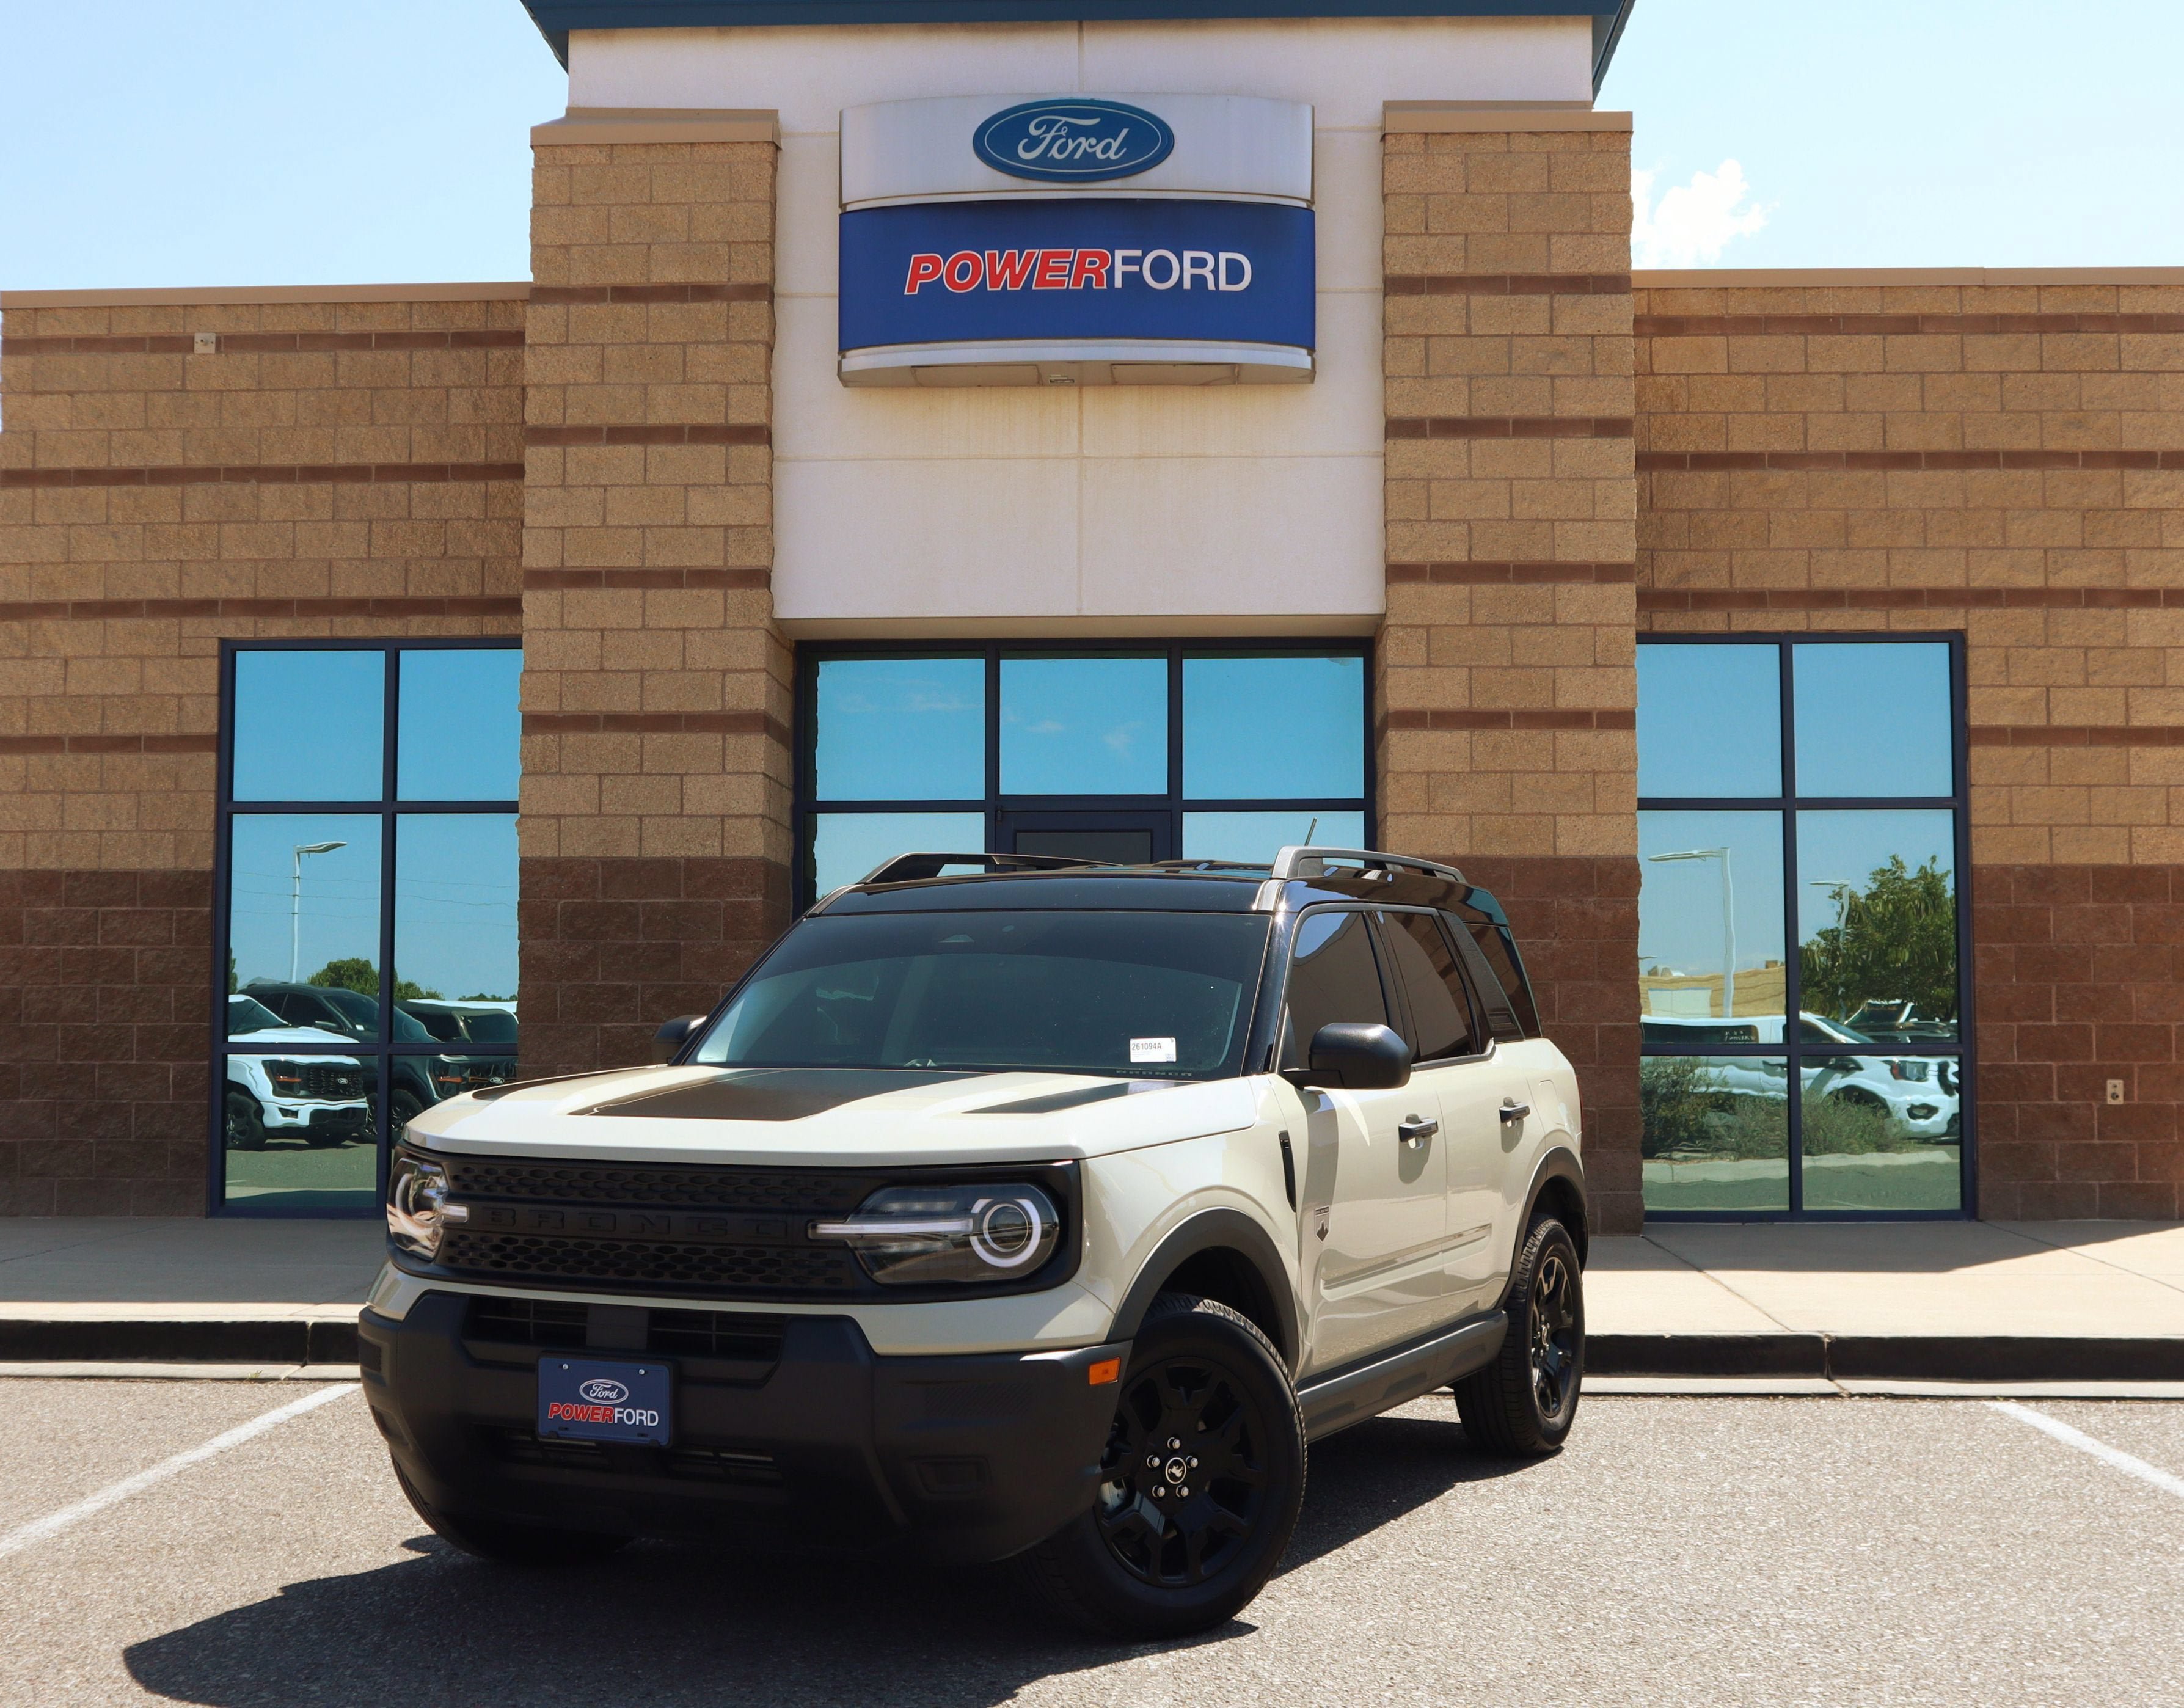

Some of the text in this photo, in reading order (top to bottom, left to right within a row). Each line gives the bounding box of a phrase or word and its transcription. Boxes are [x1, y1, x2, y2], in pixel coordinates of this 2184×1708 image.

[1017, 115, 1130, 161] Ford
[481, 1206, 788, 1239] BRONCO
[590, 1383, 619, 1400] Ford
